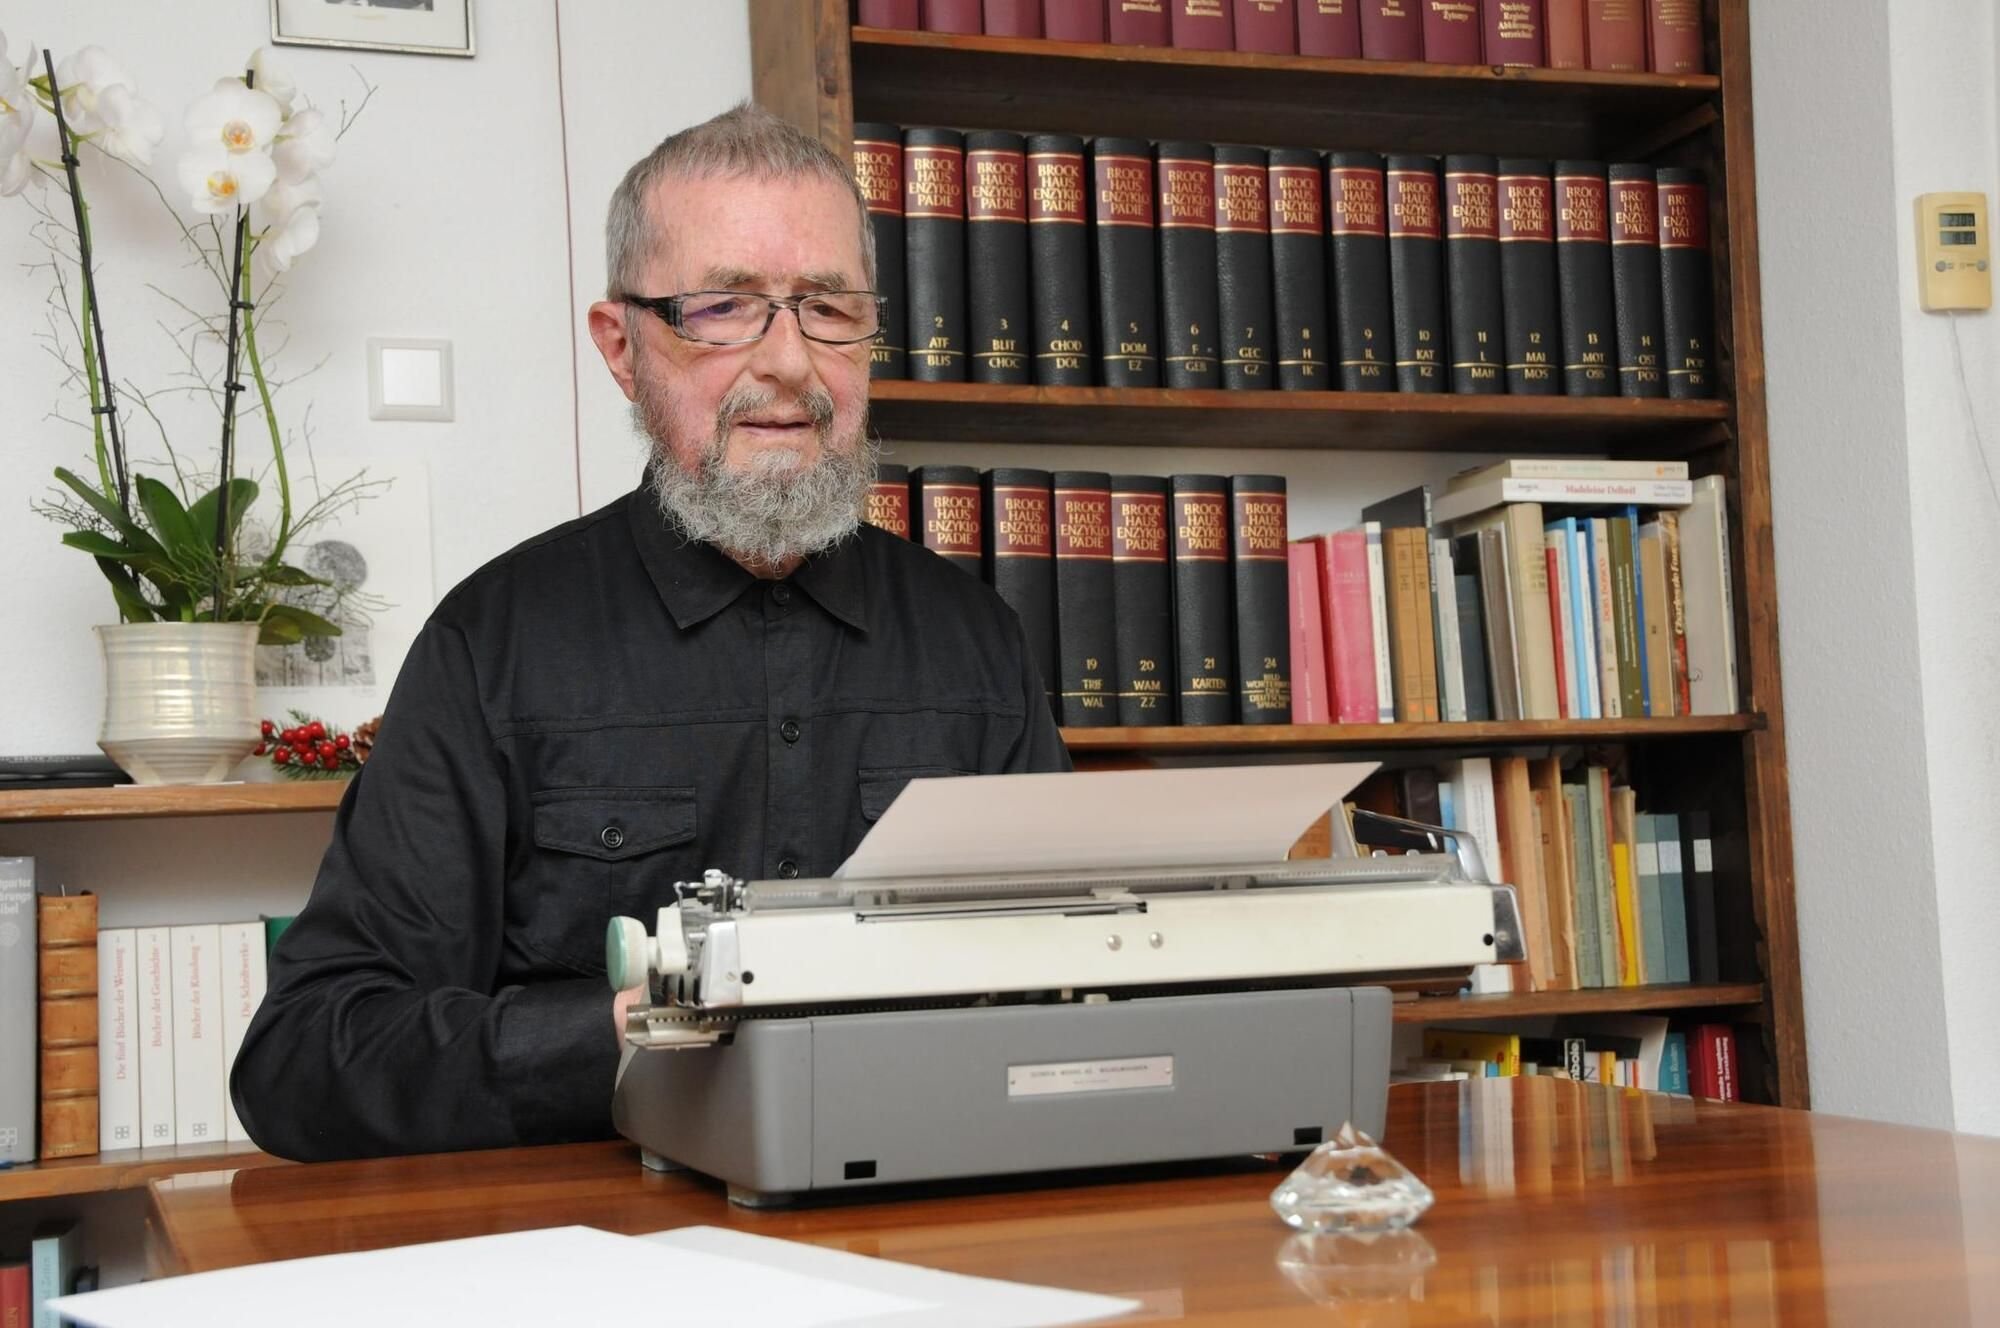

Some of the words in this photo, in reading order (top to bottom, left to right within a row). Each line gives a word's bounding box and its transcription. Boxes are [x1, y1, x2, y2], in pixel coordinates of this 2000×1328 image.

[853, 151, 894, 166] BROCK
[914, 158, 955, 171] BROCK
[856, 164, 890, 177] HAUS
[977, 161, 1017, 175] BROCK
[1037, 163, 1078, 177] BROCK
[1106, 167, 1144, 180] BROCK
[917, 170, 952, 182] HAUS
[980, 174, 1014, 186] HAUS
[1041, 175, 1076, 188] HAUS
[1168, 169, 1207, 182] BROCK
[1223, 175, 1261, 188] BROCK
[855, 176, 898, 190] NZYKLO
[909, 181, 960, 195] ENZYKLO
[1110, 179, 1142, 191] HAUS
[1171, 181, 1203, 194] HAUS
[1279, 176, 1314, 190] BROCK
[1340, 178, 1377, 191] BROCK
[972, 185, 1021, 198] ENZYKLO
[1033, 187, 1083, 200] ENZYKLO
[1102, 190, 1149, 204] ENZYKLO
[1227, 187, 1258, 199] HAUS
[1283, 188, 1313, 200] HAUS
[1344, 189, 1375, 201] HAUS
[1508, 186, 1544, 198] BROCK
[1163, 193, 1210, 207] ENZYKLO
[1218, 197, 1265, 211] ENZYKLO
[1402, 192, 1431, 204] HAUS
[1460, 194, 1491, 206] HAUS
[1512, 197, 1543, 209] HAUS
[1570, 197, 1599, 209] HAUS
[1275, 200, 1320, 213] ENZYKLO
[1336, 201, 1381, 214] ENZYKLO
[1503, 208, 1549, 221] ENZYKLO
[934, 316, 944, 328] 2
[1000, 318, 1008, 330] 3
[1061, 320, 1069, 331] 4
[1130, 322, 1138, 333] 5
[1190, 323, 1199, 335] 6
[1246, 327, 1253, 339] 7
[1302, 328, 1310, 339] 8
[1364, 328, 1373, 340] 9
[1419, 330, 1430, 341] 10
[1478, 331, 1487, 343] 11
[1530, 333, 1540, 344] 12
[1588, 333, 1598, 344] 13
[928, 336, 950, 348] ATF
[992, 339, 1016, 350] BLIT
[1050, 340, 1082, 351] CHOD
[1120, 342, 1147, 353] DOM
[1191, 344, 1199, 355] F
[1302, 348, 1312, 359] H
[1416, 349, 1434, 360] KAT
[870, 351, 891, 362] ATE
[927, 355, 951, 366] BLIS
[1480, 351, 1487, 361] L
[988, 357, 1020, 368] CHOC
[1056, 357, 1080, 369] DOL
[1128, 360, 1143, 371] EZ
[1360, 366, 1380, 376] KAS
[1524, 369, 1548, 379] MOS
[867, 494, 902, 507] ROCK
[933, 496, 975, 509] BROCK
[1005, 498, 1045, 511] BROCK
[1065, 501, 1105, 513] BROCK
[1121, 503, 1160, 516] BROCK
[1184, 503, 1223, 516] BROCK
[1245, 503, 1283, 515] BROCK
[937, 508, 971, 520] HAUS
[1008, 510, 1041, 522] HAUS
[1069, 512, 1102, 524] HAUS
[1187, 514, 1220, 526] HAUS
[1248, 514, 1280, 526] HAUS
[928, 520, 979, 533] ENZYKLO
[1125, 515, 1158, 527] HAUS
[1000, 521, 1048, 534] ENZYKLO
[1060, 523, 1109, 536] ENZYKLO
[1116, 526, 1166, 540] ENZYKLO
[1179, 526, 1226, 538] ENZYKLO
[1241, 526, 1286, 538] ENZYKLO
[1086, 658, 1098, 671] 19
[1139, 659, 1155, 671] 20
[1204, 657, 1215, 669] 21
[1263, 657, 1277, 669] 24
[1133, 680, 1161, 691] WAM
[1192, 678, 1226, 689] KARTEN
[1082, 696, 1104, 708] WAL
[113, 989, 125, 1004] der
[190, 991, 200, 1005] der
[150, 998, 161, 1013] der
[114, 1006, 126, 1039] Bücher
[191, 1007, 202, 1039] Bücher
[151, 1015, 163, 1047] Bücher
